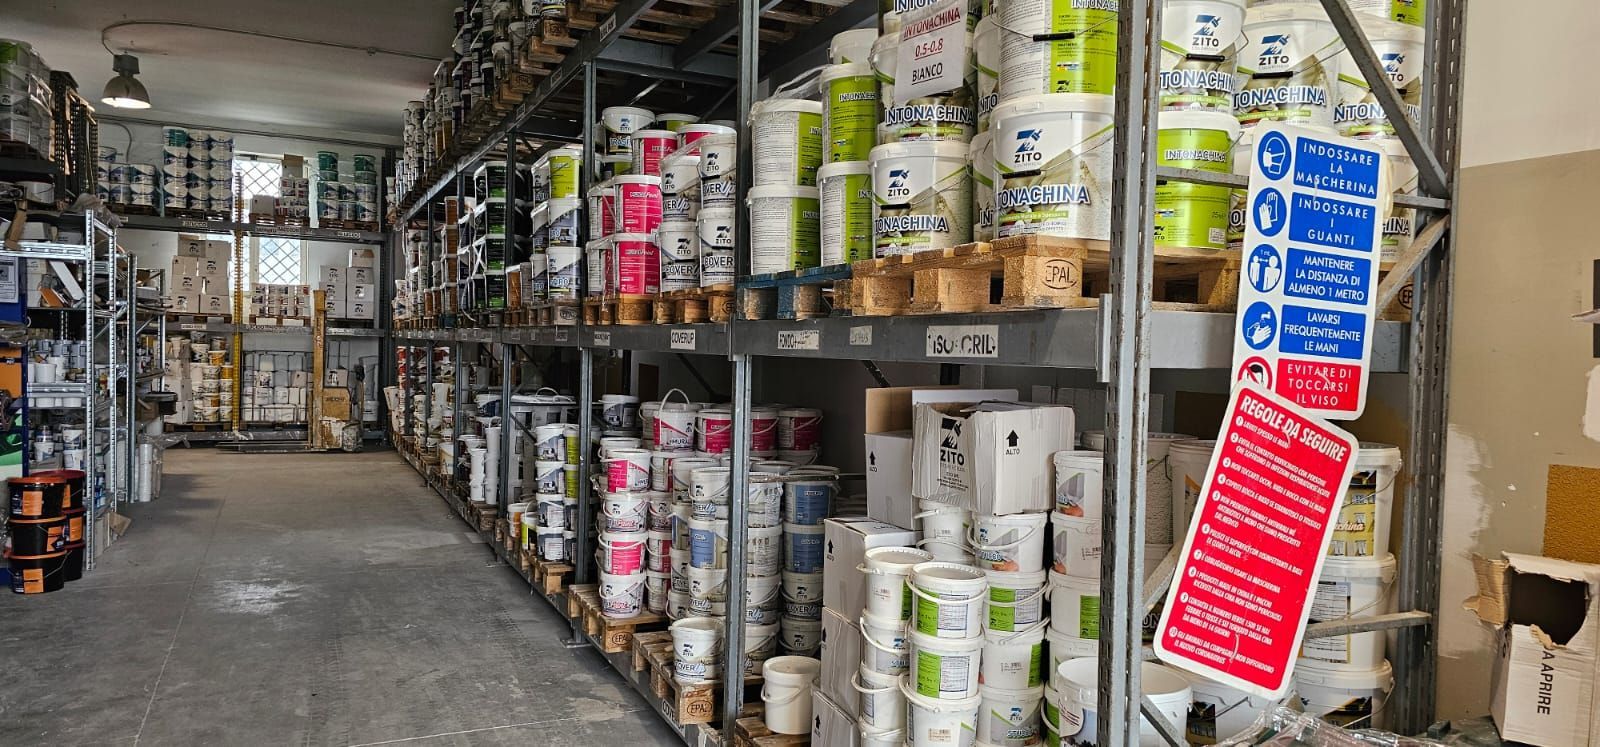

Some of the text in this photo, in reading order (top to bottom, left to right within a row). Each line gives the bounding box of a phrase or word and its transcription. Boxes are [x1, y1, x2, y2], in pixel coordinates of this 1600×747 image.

[904, 8, 960, 38] INTONACHINA
[915, 38, 944, 58] 0.5-0.8
[1192, 37, 1220, 47] ZITO
[1258, 56, 1290, 66] ZITO
[912, 62, 944, 82] BIANCO
[1014, 152, 1042, 163] ZITO
[1303, 142, 1373, 166] INDOSSARE
[1330, 163, 1344, 175] LA
[1296, 172, 1376, 195] MASCHERINA
[888, 188, 910, 197] ZITO
[1298, 198, 1369, 220] INDOSSARE
[1308, 230, 1355, 246] GUANTI
[1304, 255, 1354, 271] MANTENERE
[1046, 264, 1074, 284] EPAL
[1296, 268, 1360, 286] LA DISTANZA DI
[1288, 284, 1325, 297] ALMENO
[1335, 288, 1364, 301] METRO
[1308, 312, 1341, 325] LAVARSI
[1284, 324, 1361, 341] FREQUENTEMENTE
[1304, 341, 1339, 354] LE MANI
[1288, 364, 1352, 378] EVITARE DI
[1288, 378, 1348, 392] TOCCARSI
[1296, 394, 1339, 406] IL VISO
[1240, 395, 1348, 463] REGOLE DA SEGUIRE
[940, 450, 964, 466] ZITO
[1537, 650, 1555, 715] A APRIRE
